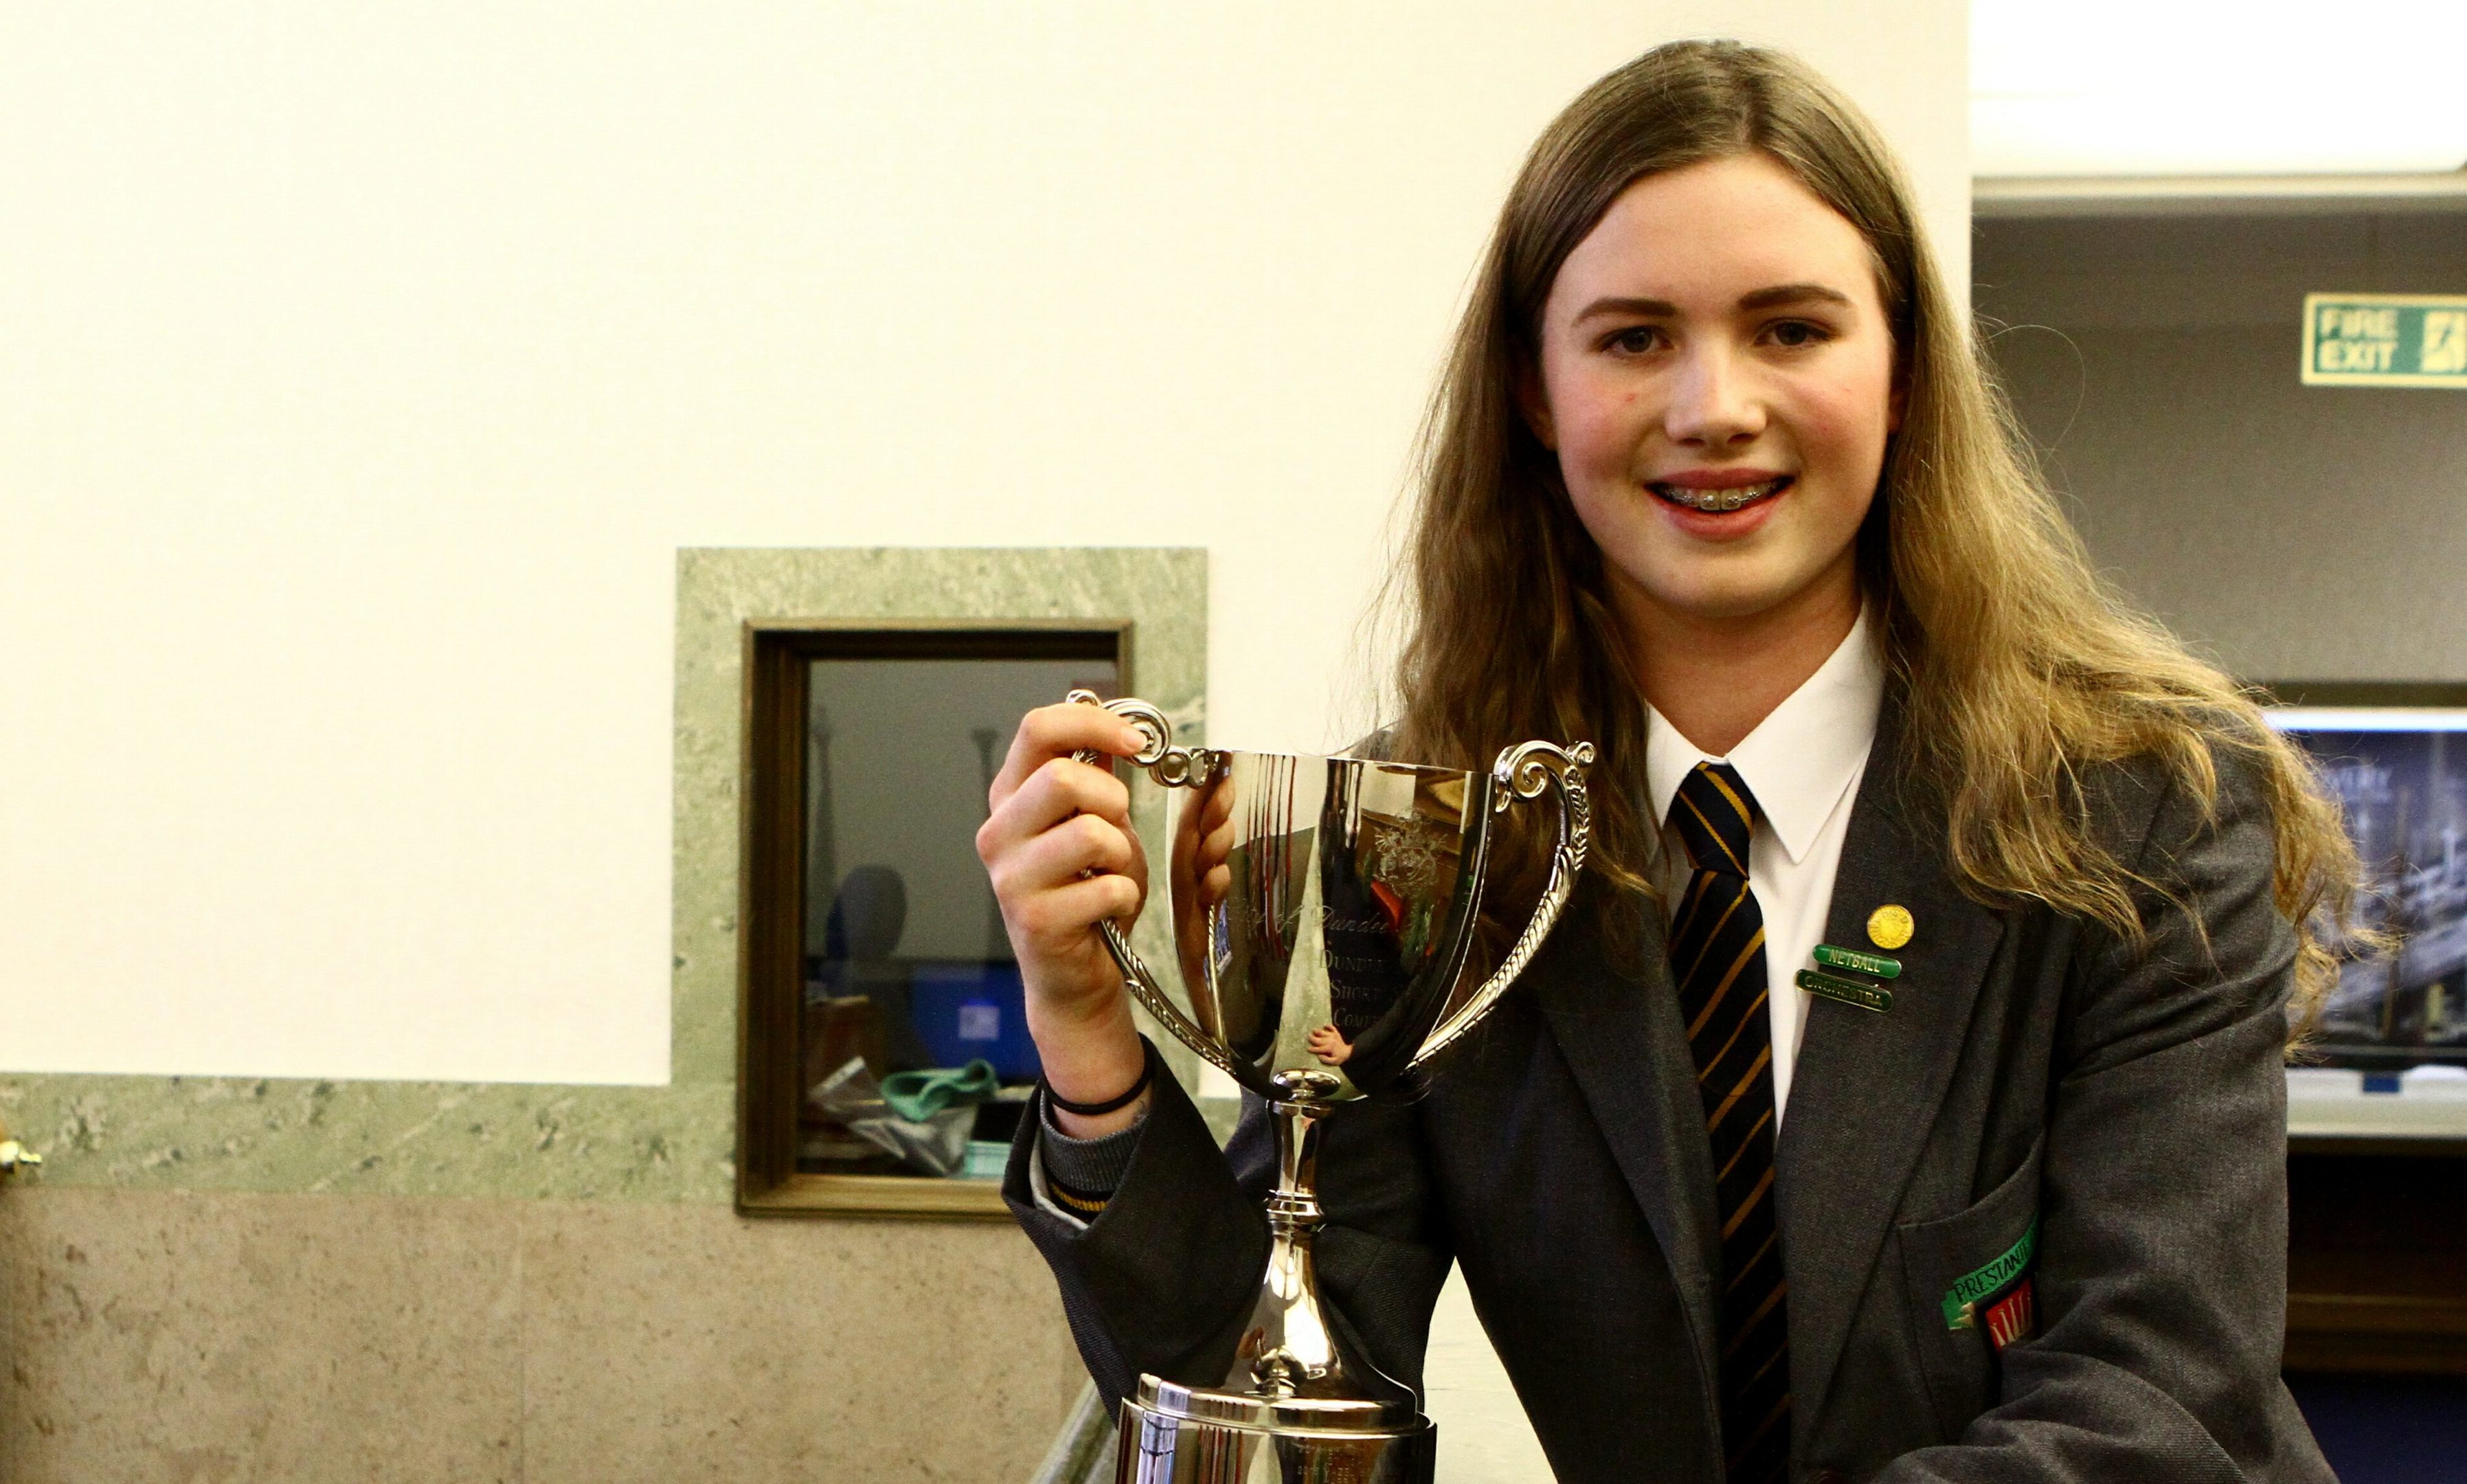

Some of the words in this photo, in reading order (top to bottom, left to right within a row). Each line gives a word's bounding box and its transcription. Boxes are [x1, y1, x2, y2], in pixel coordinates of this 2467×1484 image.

[2320, 308, 2397, 337] FIRE
[2319, 340, 2397, 370] EXIT
[1828, 949, 1880, 973] NETBALL
